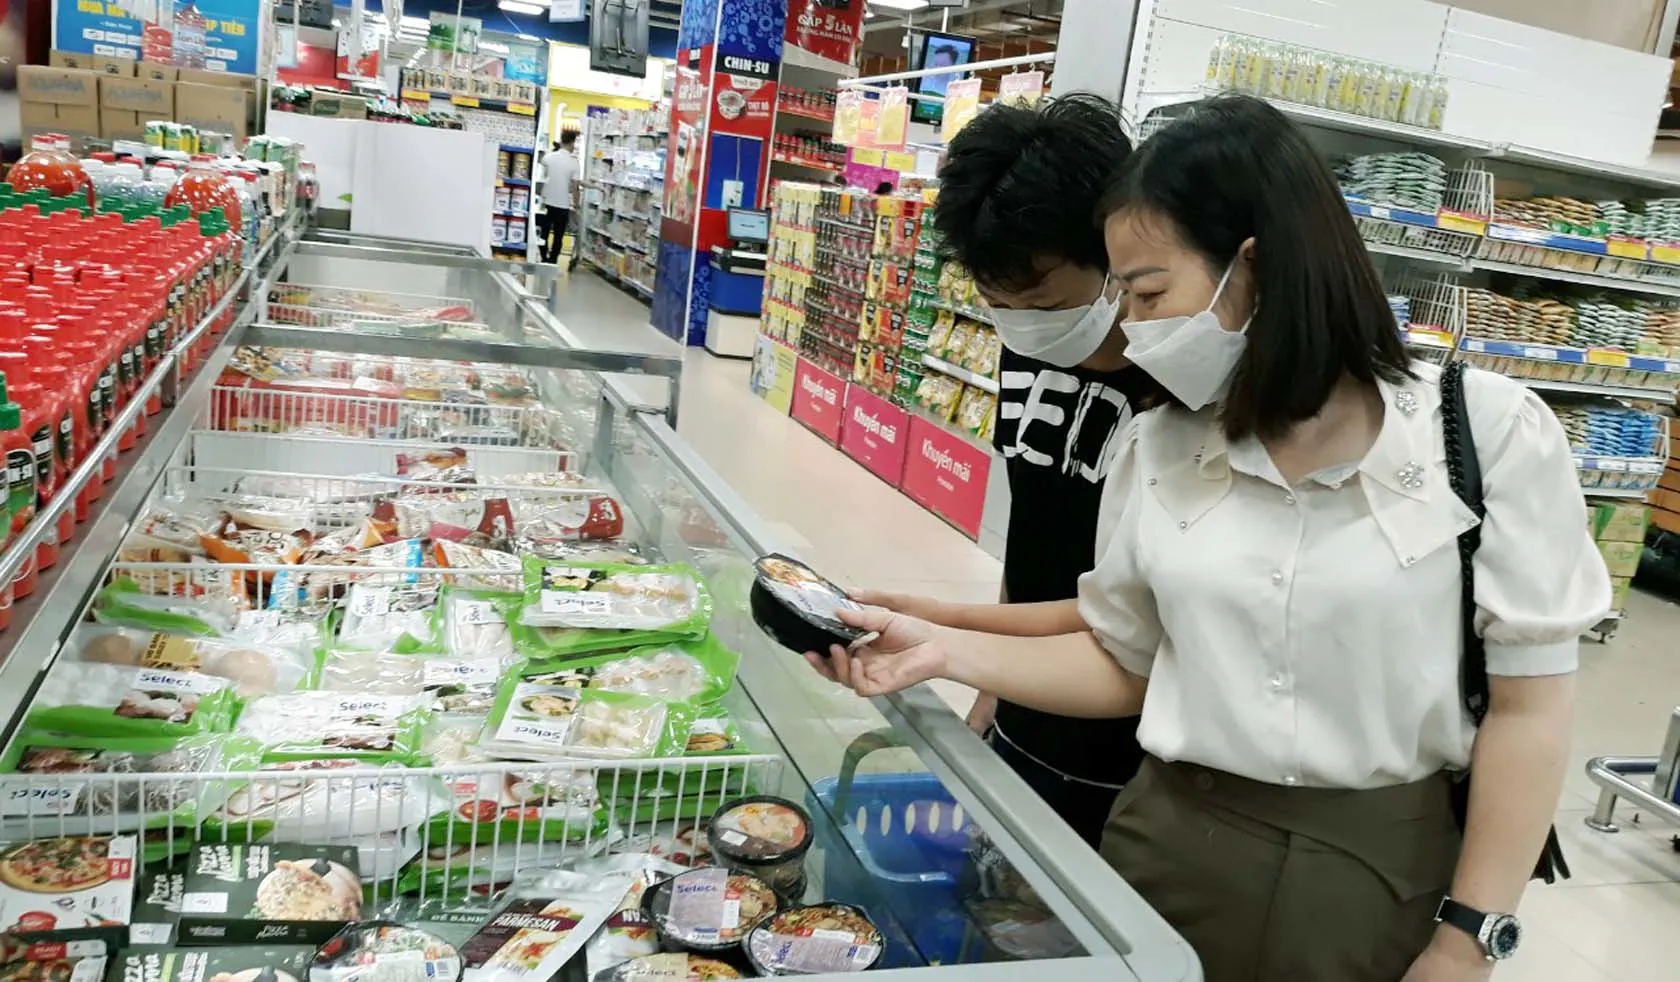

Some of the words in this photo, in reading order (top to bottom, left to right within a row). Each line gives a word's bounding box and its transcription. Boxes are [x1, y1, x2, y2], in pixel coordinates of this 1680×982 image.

[724, 56, 770, 74] CHIN-SU
[853, 405, 881, 432] Khuyến
[879, 424, 897, 444] mãi
[922, 437, 953, 475] Khuyến
[952, 461, 972, 483] mãi
[139, 672, 192, 688] Select
[513, 725, 562, 741] Select
[146, 873, 172, 905] Pizza
[676, 883, 717, 894] Select
[491, 914, 560, 931] PARMESAN
